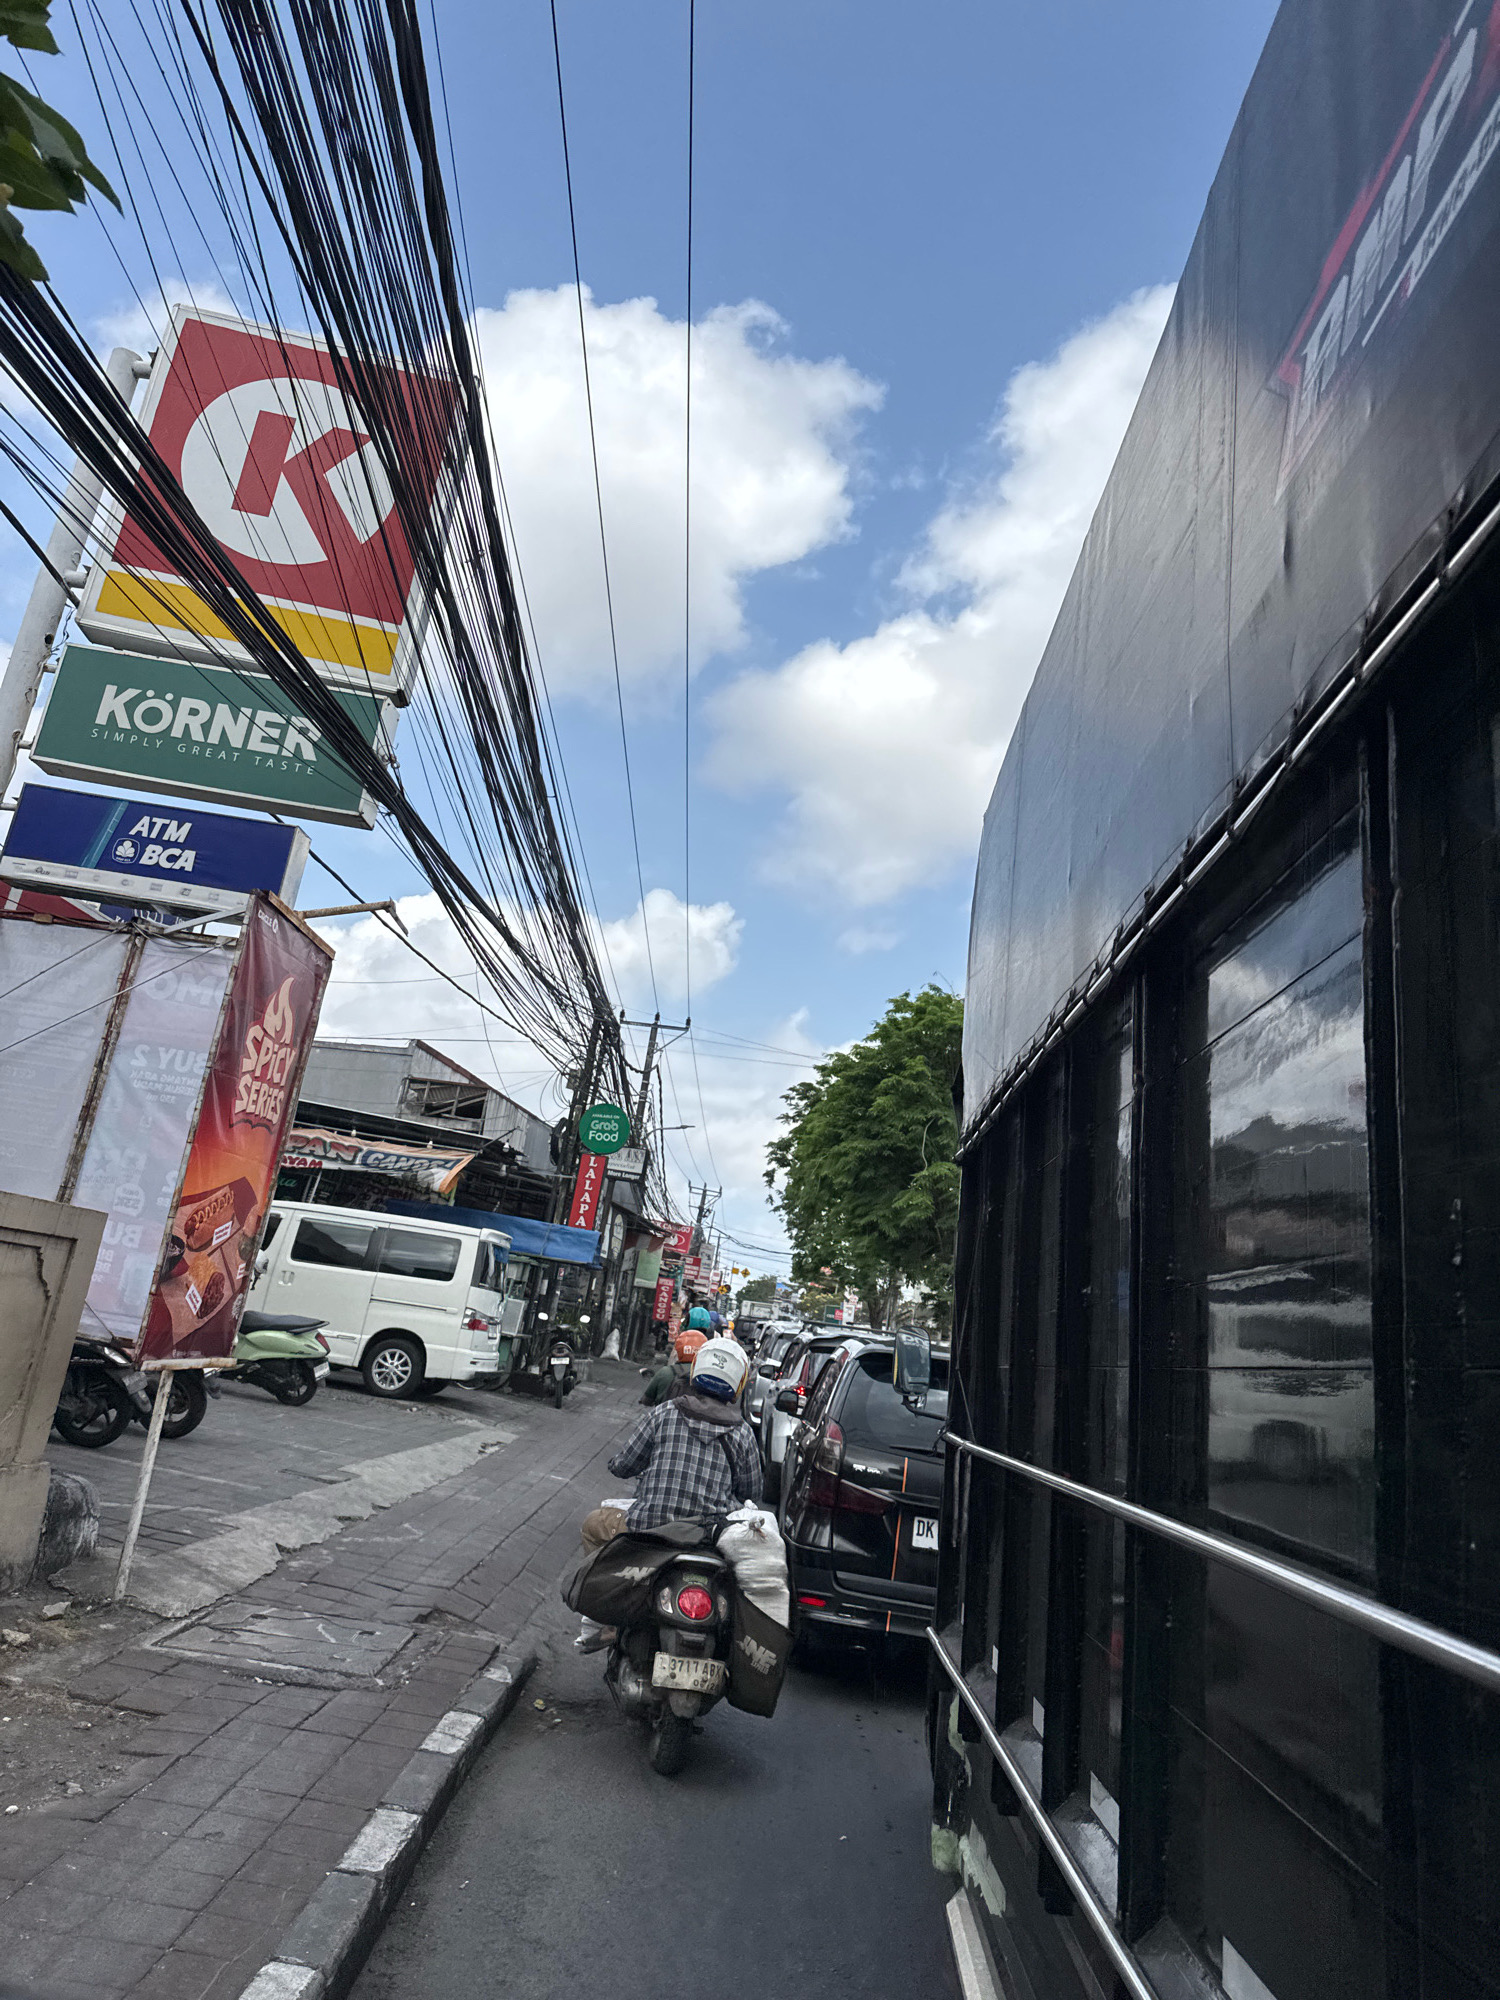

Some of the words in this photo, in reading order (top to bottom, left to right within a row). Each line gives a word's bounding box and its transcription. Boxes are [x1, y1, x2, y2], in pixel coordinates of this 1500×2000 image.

[95, 684, 322, 762] KÖRNER
[91, 728, 164, 749] SIMPLY
[177, 743, 241, 762] GREAT
[255, 756, 315, 775] TASTE
[128, 815, 193, 843] ATM
[139, 844, 197, 872] BCA
[588, 1130, 619, 1142] Food
[590, 1120, 619, 1132] Grab
[916, 1519, 936, 1539] DK
[670, 1658, 699, 1674] 3717
